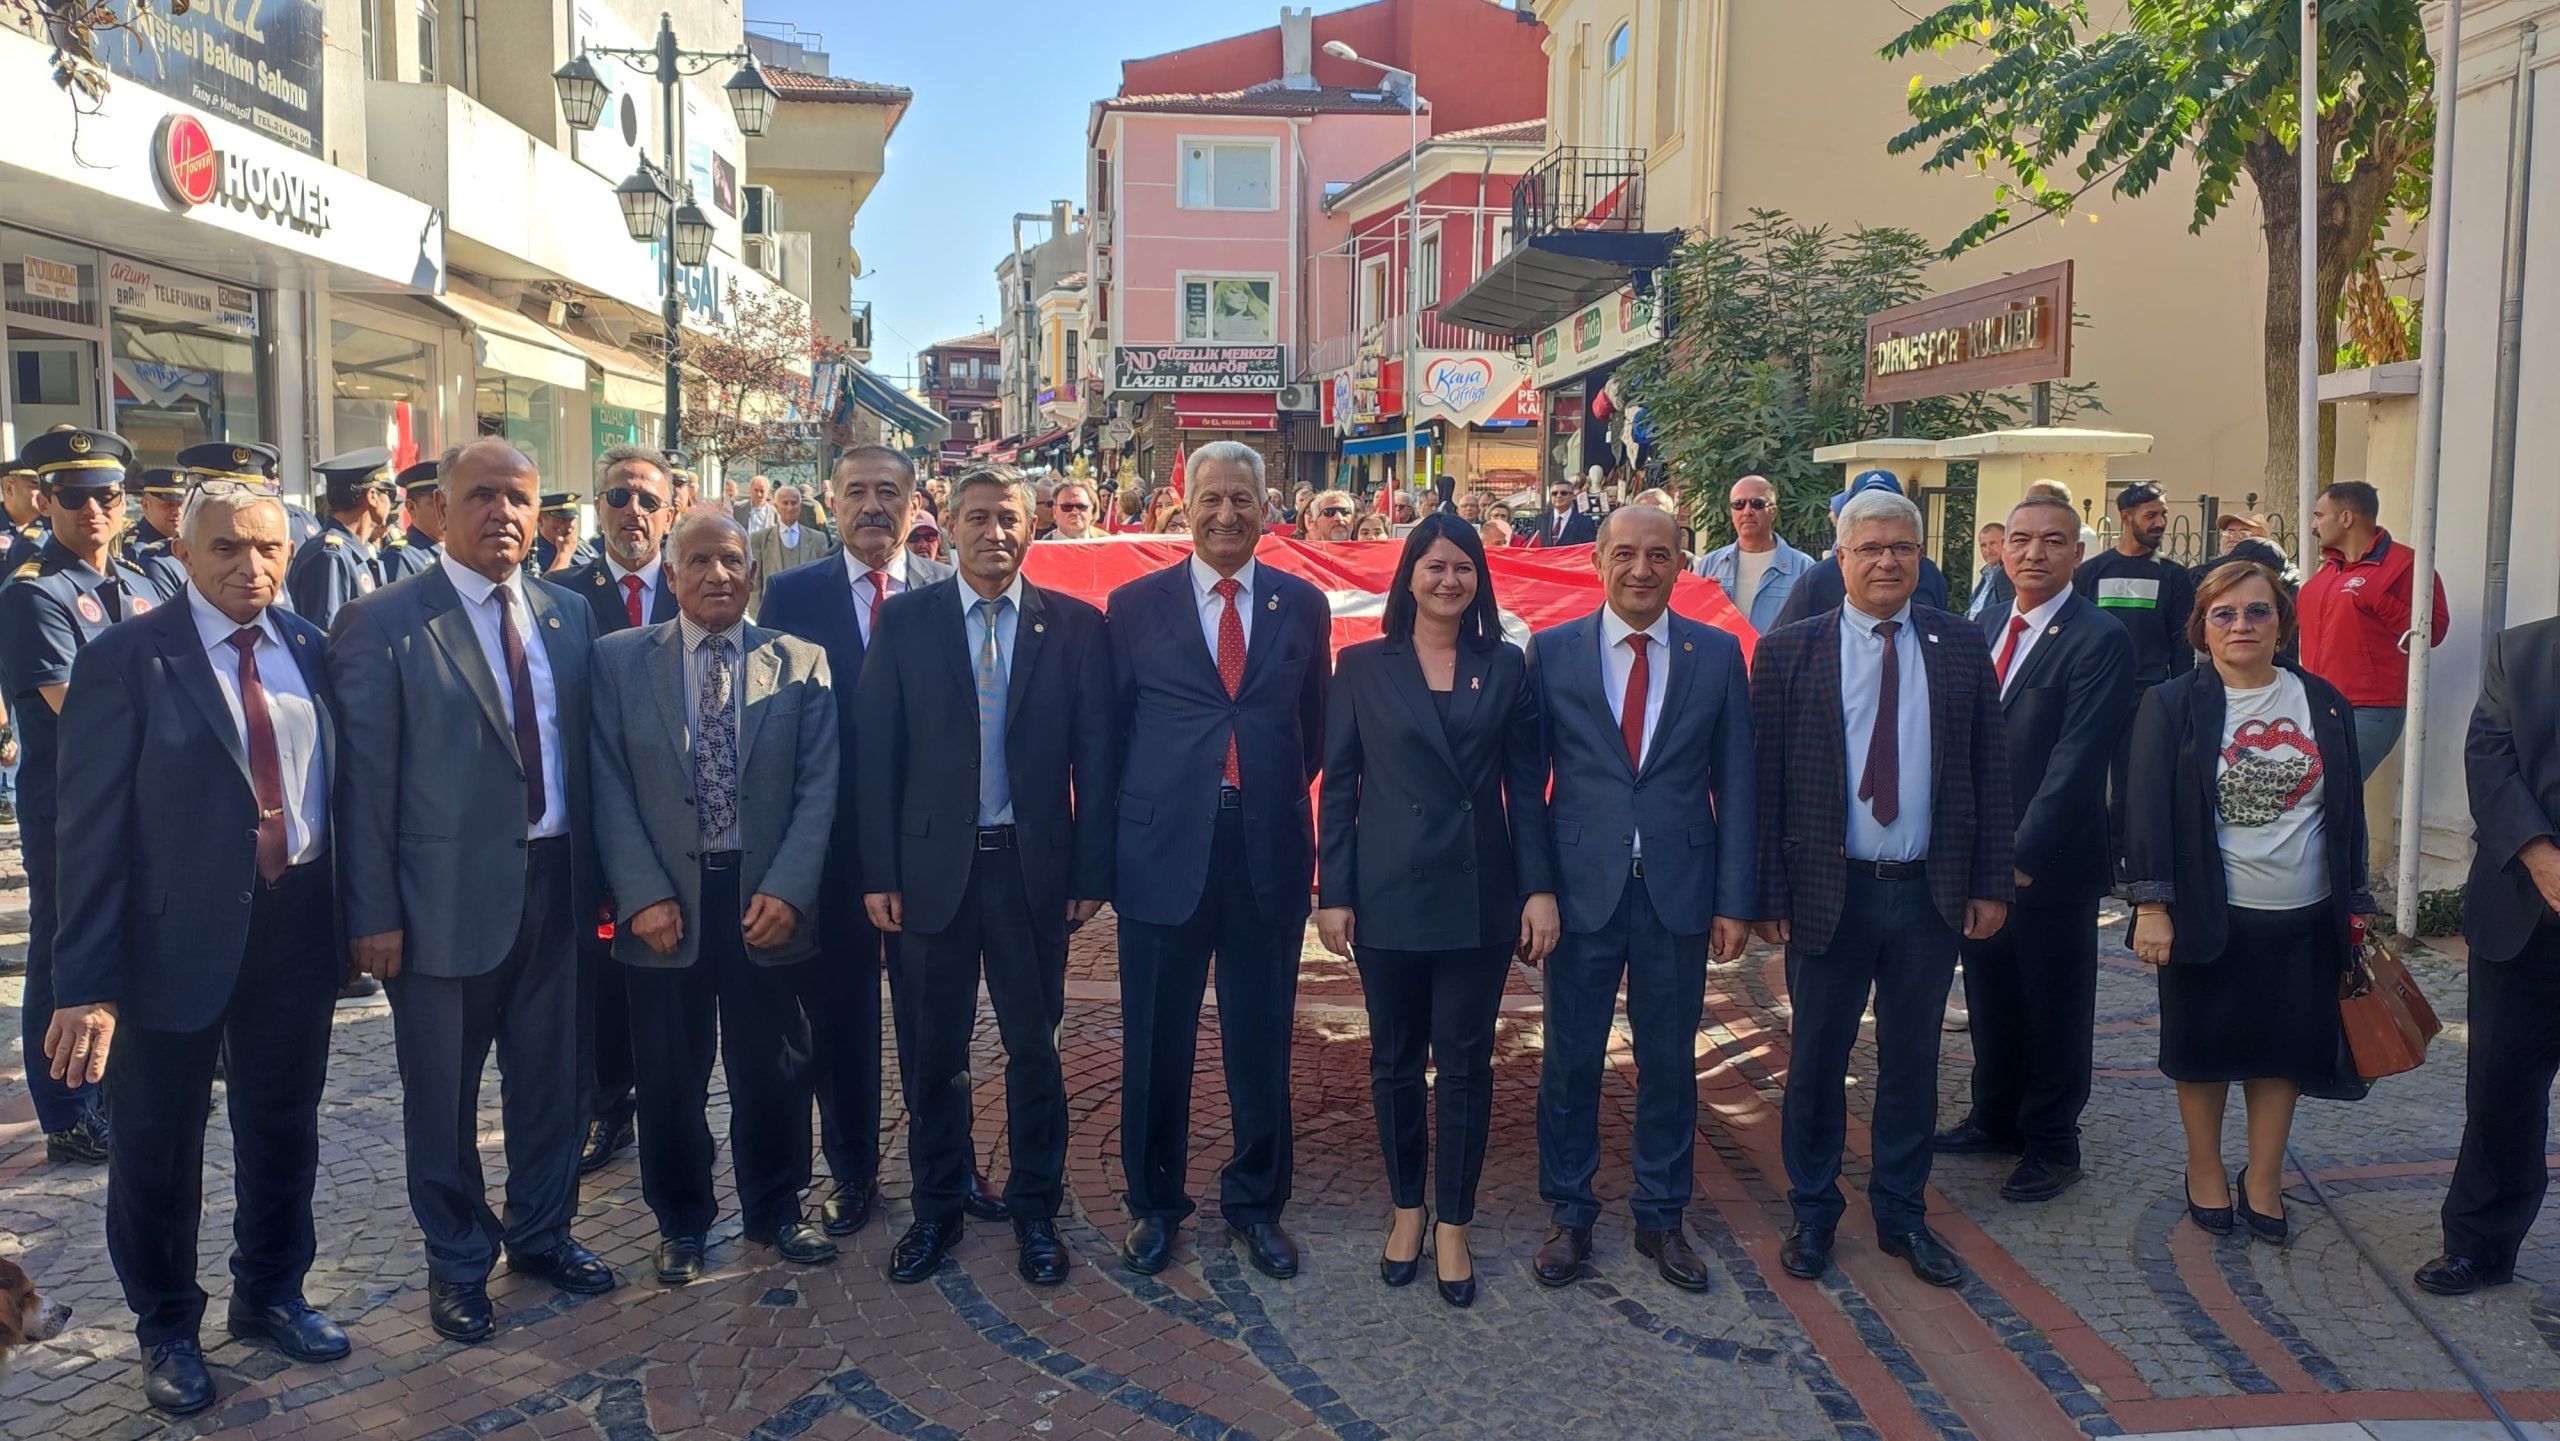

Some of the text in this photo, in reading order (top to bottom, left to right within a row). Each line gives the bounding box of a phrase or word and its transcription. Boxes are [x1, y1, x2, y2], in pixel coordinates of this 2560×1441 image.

[203, 32, 254, 85] Bakım
[257, 60, 307, 111] Salonu
[289, 129, 299, 141] 04
[300, 133, 309, 145] 00
[223, 150, 332, 230] HOOVER
[111, 262, 150, 286] arzum
[154, 284, 211, 312] TELEFUNKEN
[223, 310, 256, 330] PHILIPS
[1157, 346, 1278, 360] GÜZELLİK MERKEZİ
[1188, 360, 1248, 373] KUAFÖR
[1435, 365, 1481, 389] Kaya
[1121, 375, 1177, 388] LAZER
